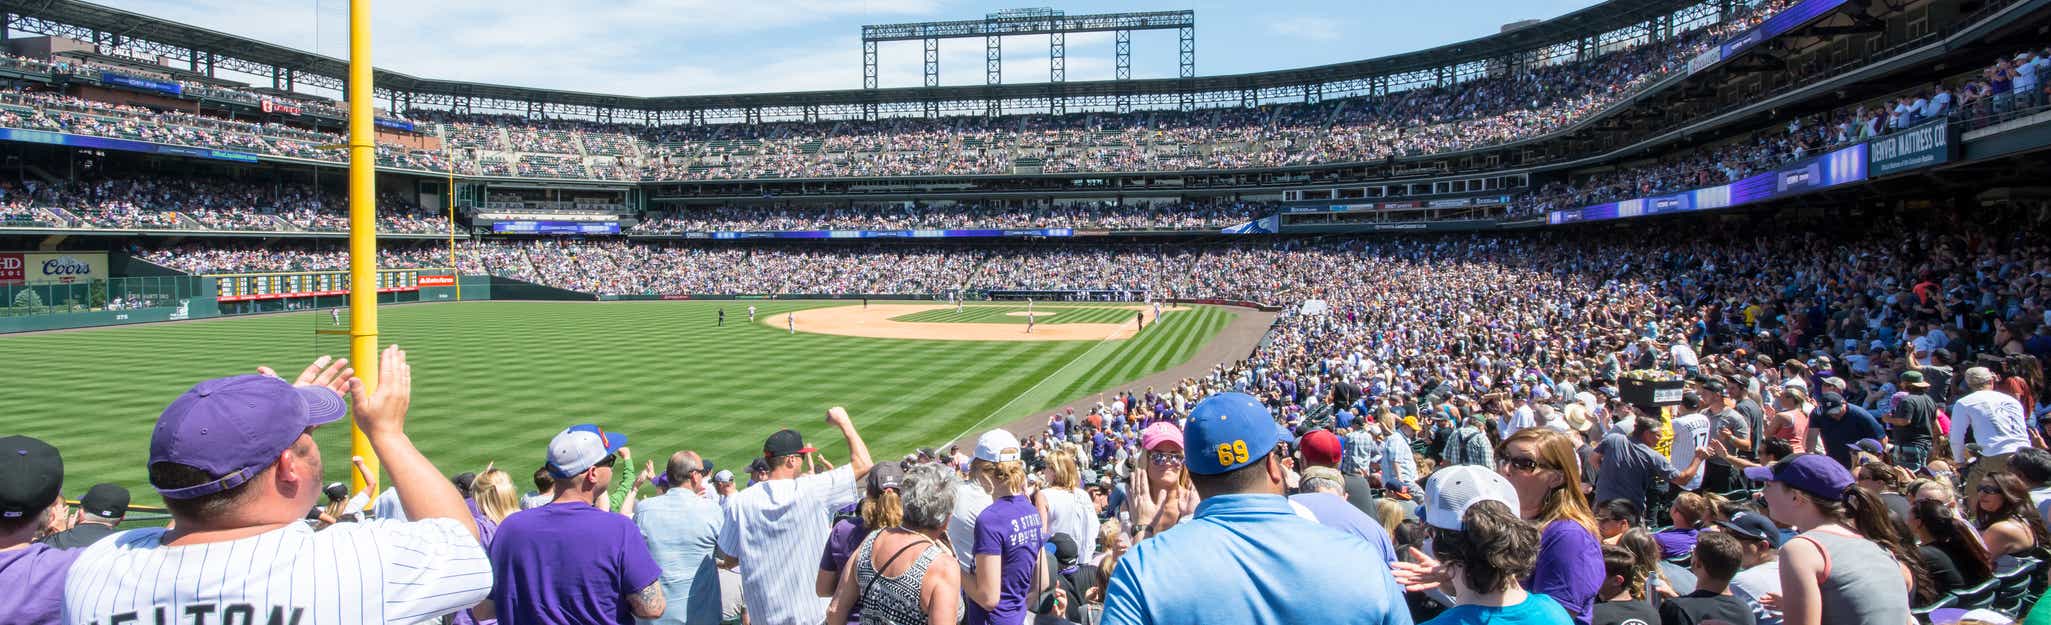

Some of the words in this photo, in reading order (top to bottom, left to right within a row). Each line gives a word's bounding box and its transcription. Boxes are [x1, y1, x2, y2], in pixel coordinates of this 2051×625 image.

[1871, 138, 1897, 163] DENVER
[1898, 127, 1933, 156] MATTRESS
[42, 259, 90, 276] Coors
[1694, 432, 1707, 448] 17
[1218, 440, 1249, 467] 69
[1011, 519, 1020, 532] 3
